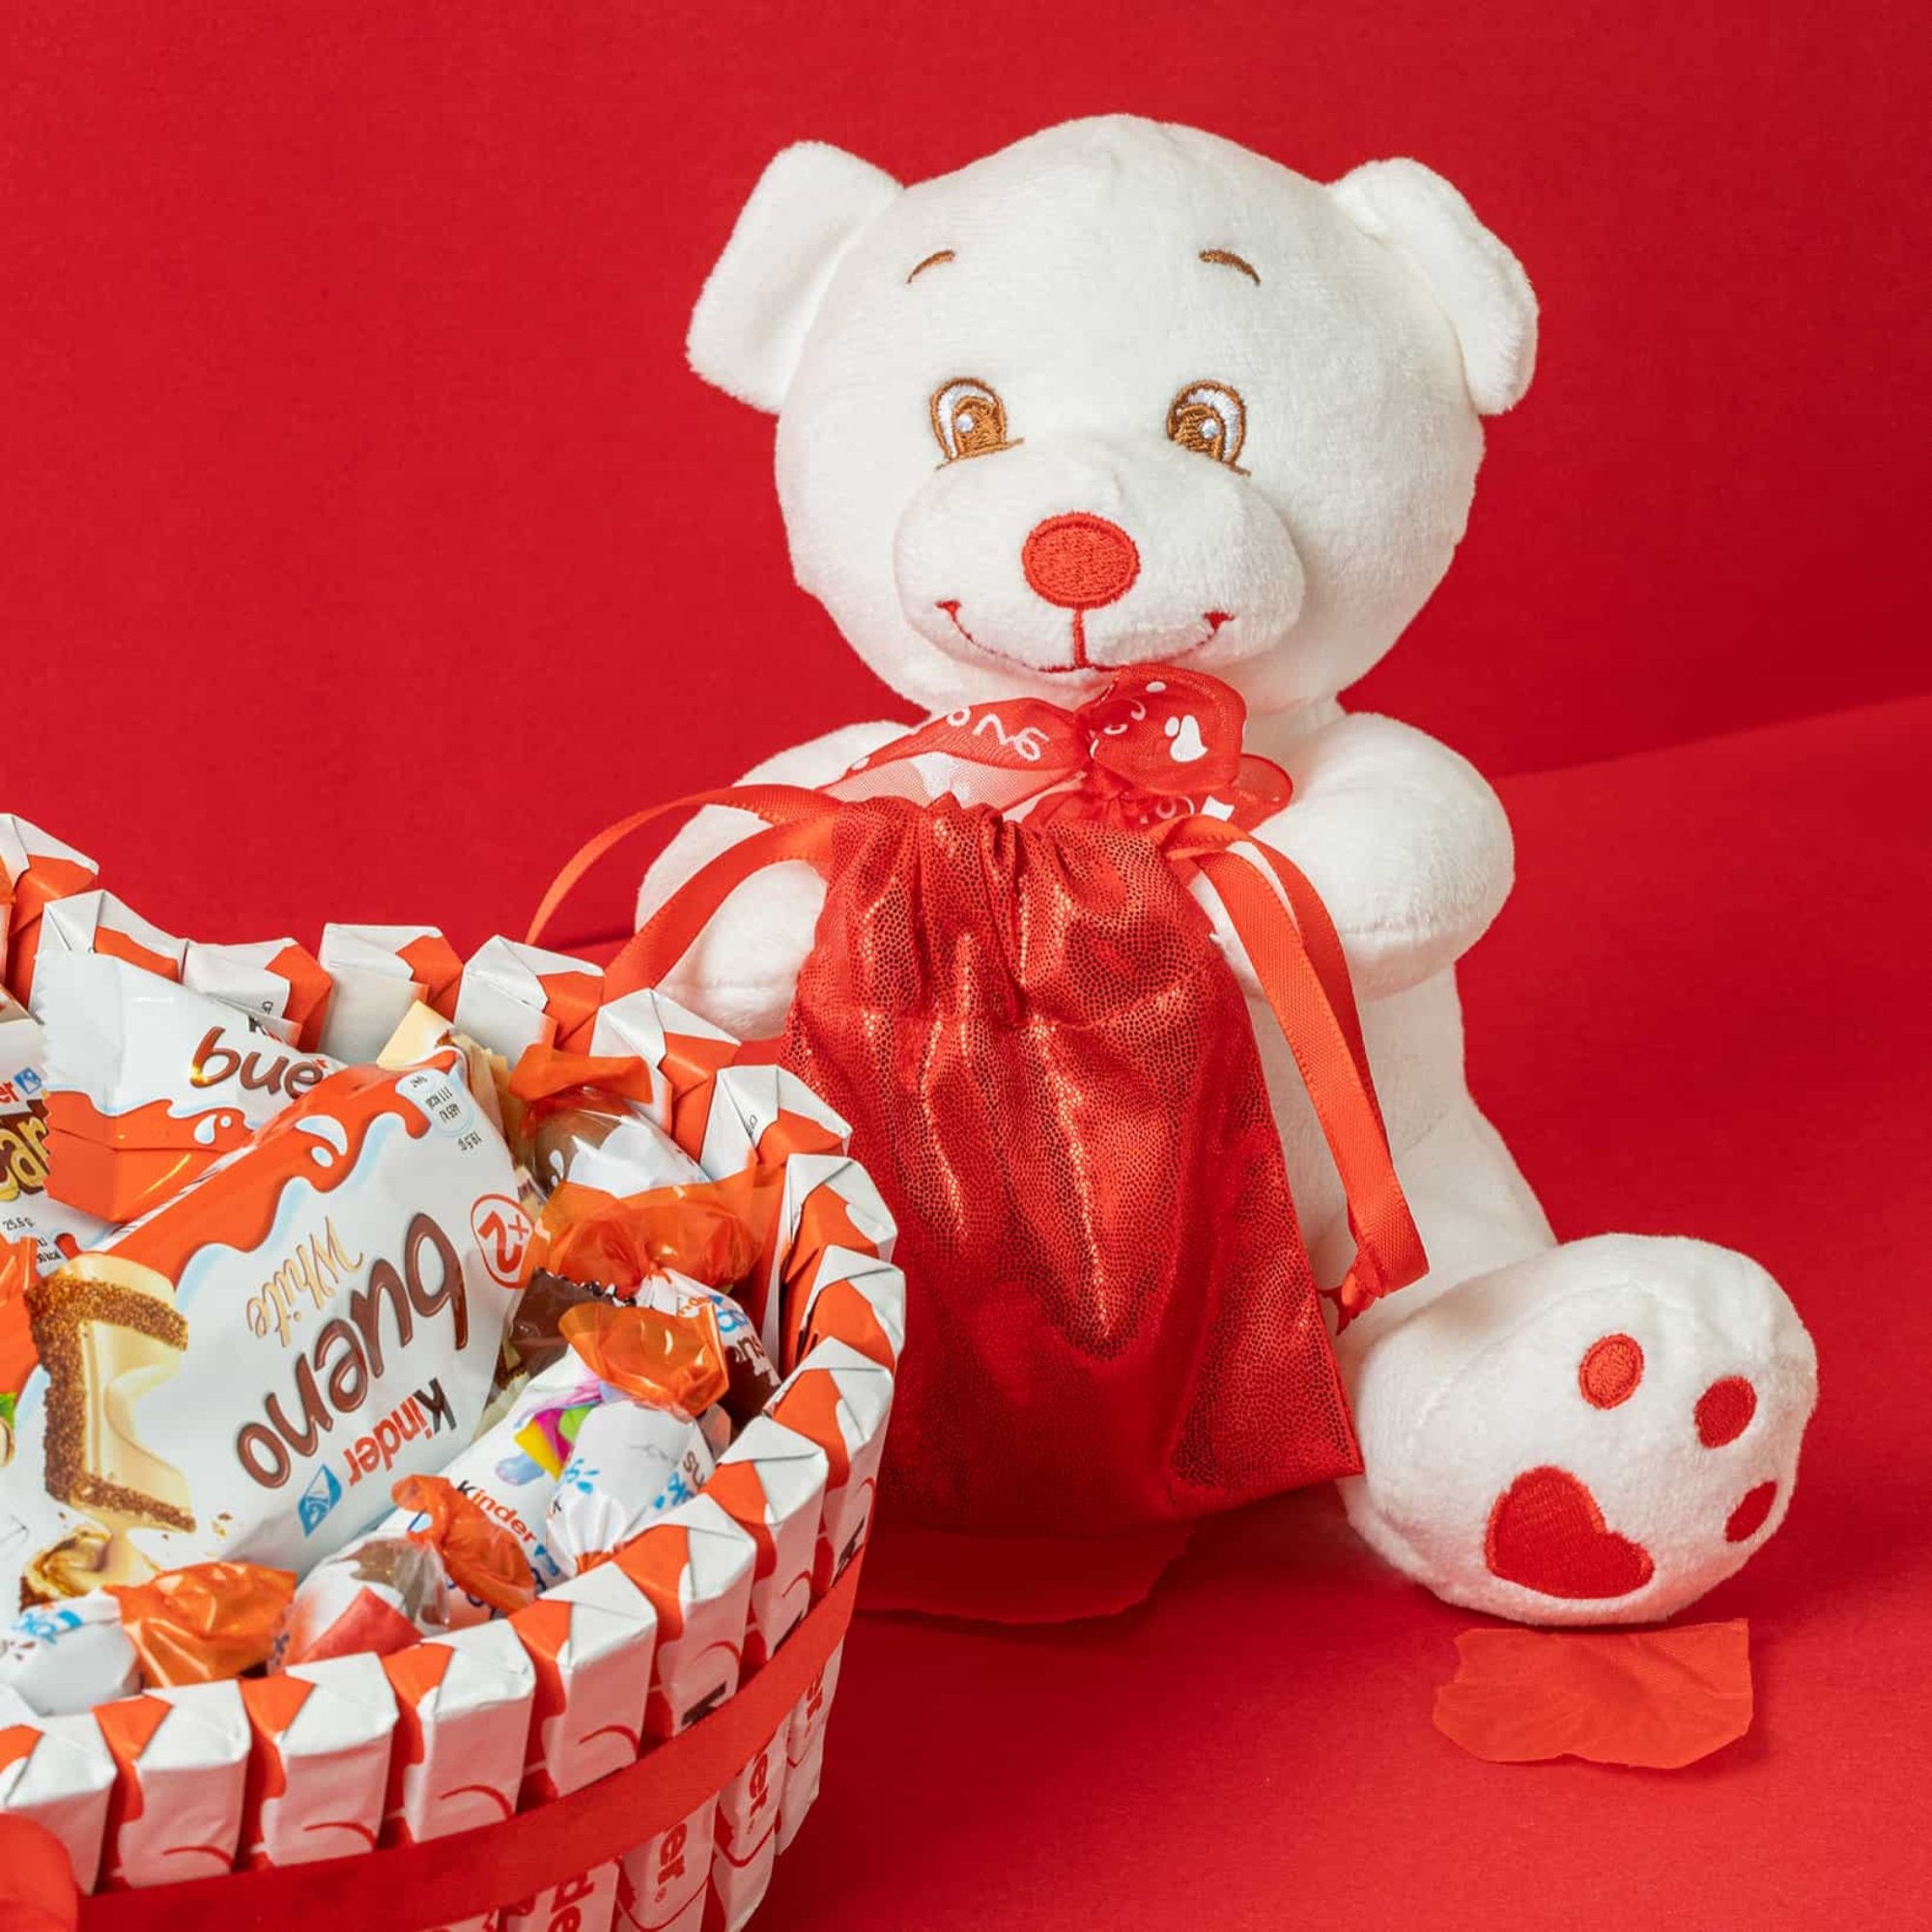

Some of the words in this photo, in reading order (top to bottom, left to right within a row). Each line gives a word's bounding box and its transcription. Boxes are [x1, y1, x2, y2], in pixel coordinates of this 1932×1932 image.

[189, 1025, 325, 1099] bue
[246, 1215, 363, 1348] White
[236, 1212, 469, 1490] bueno
